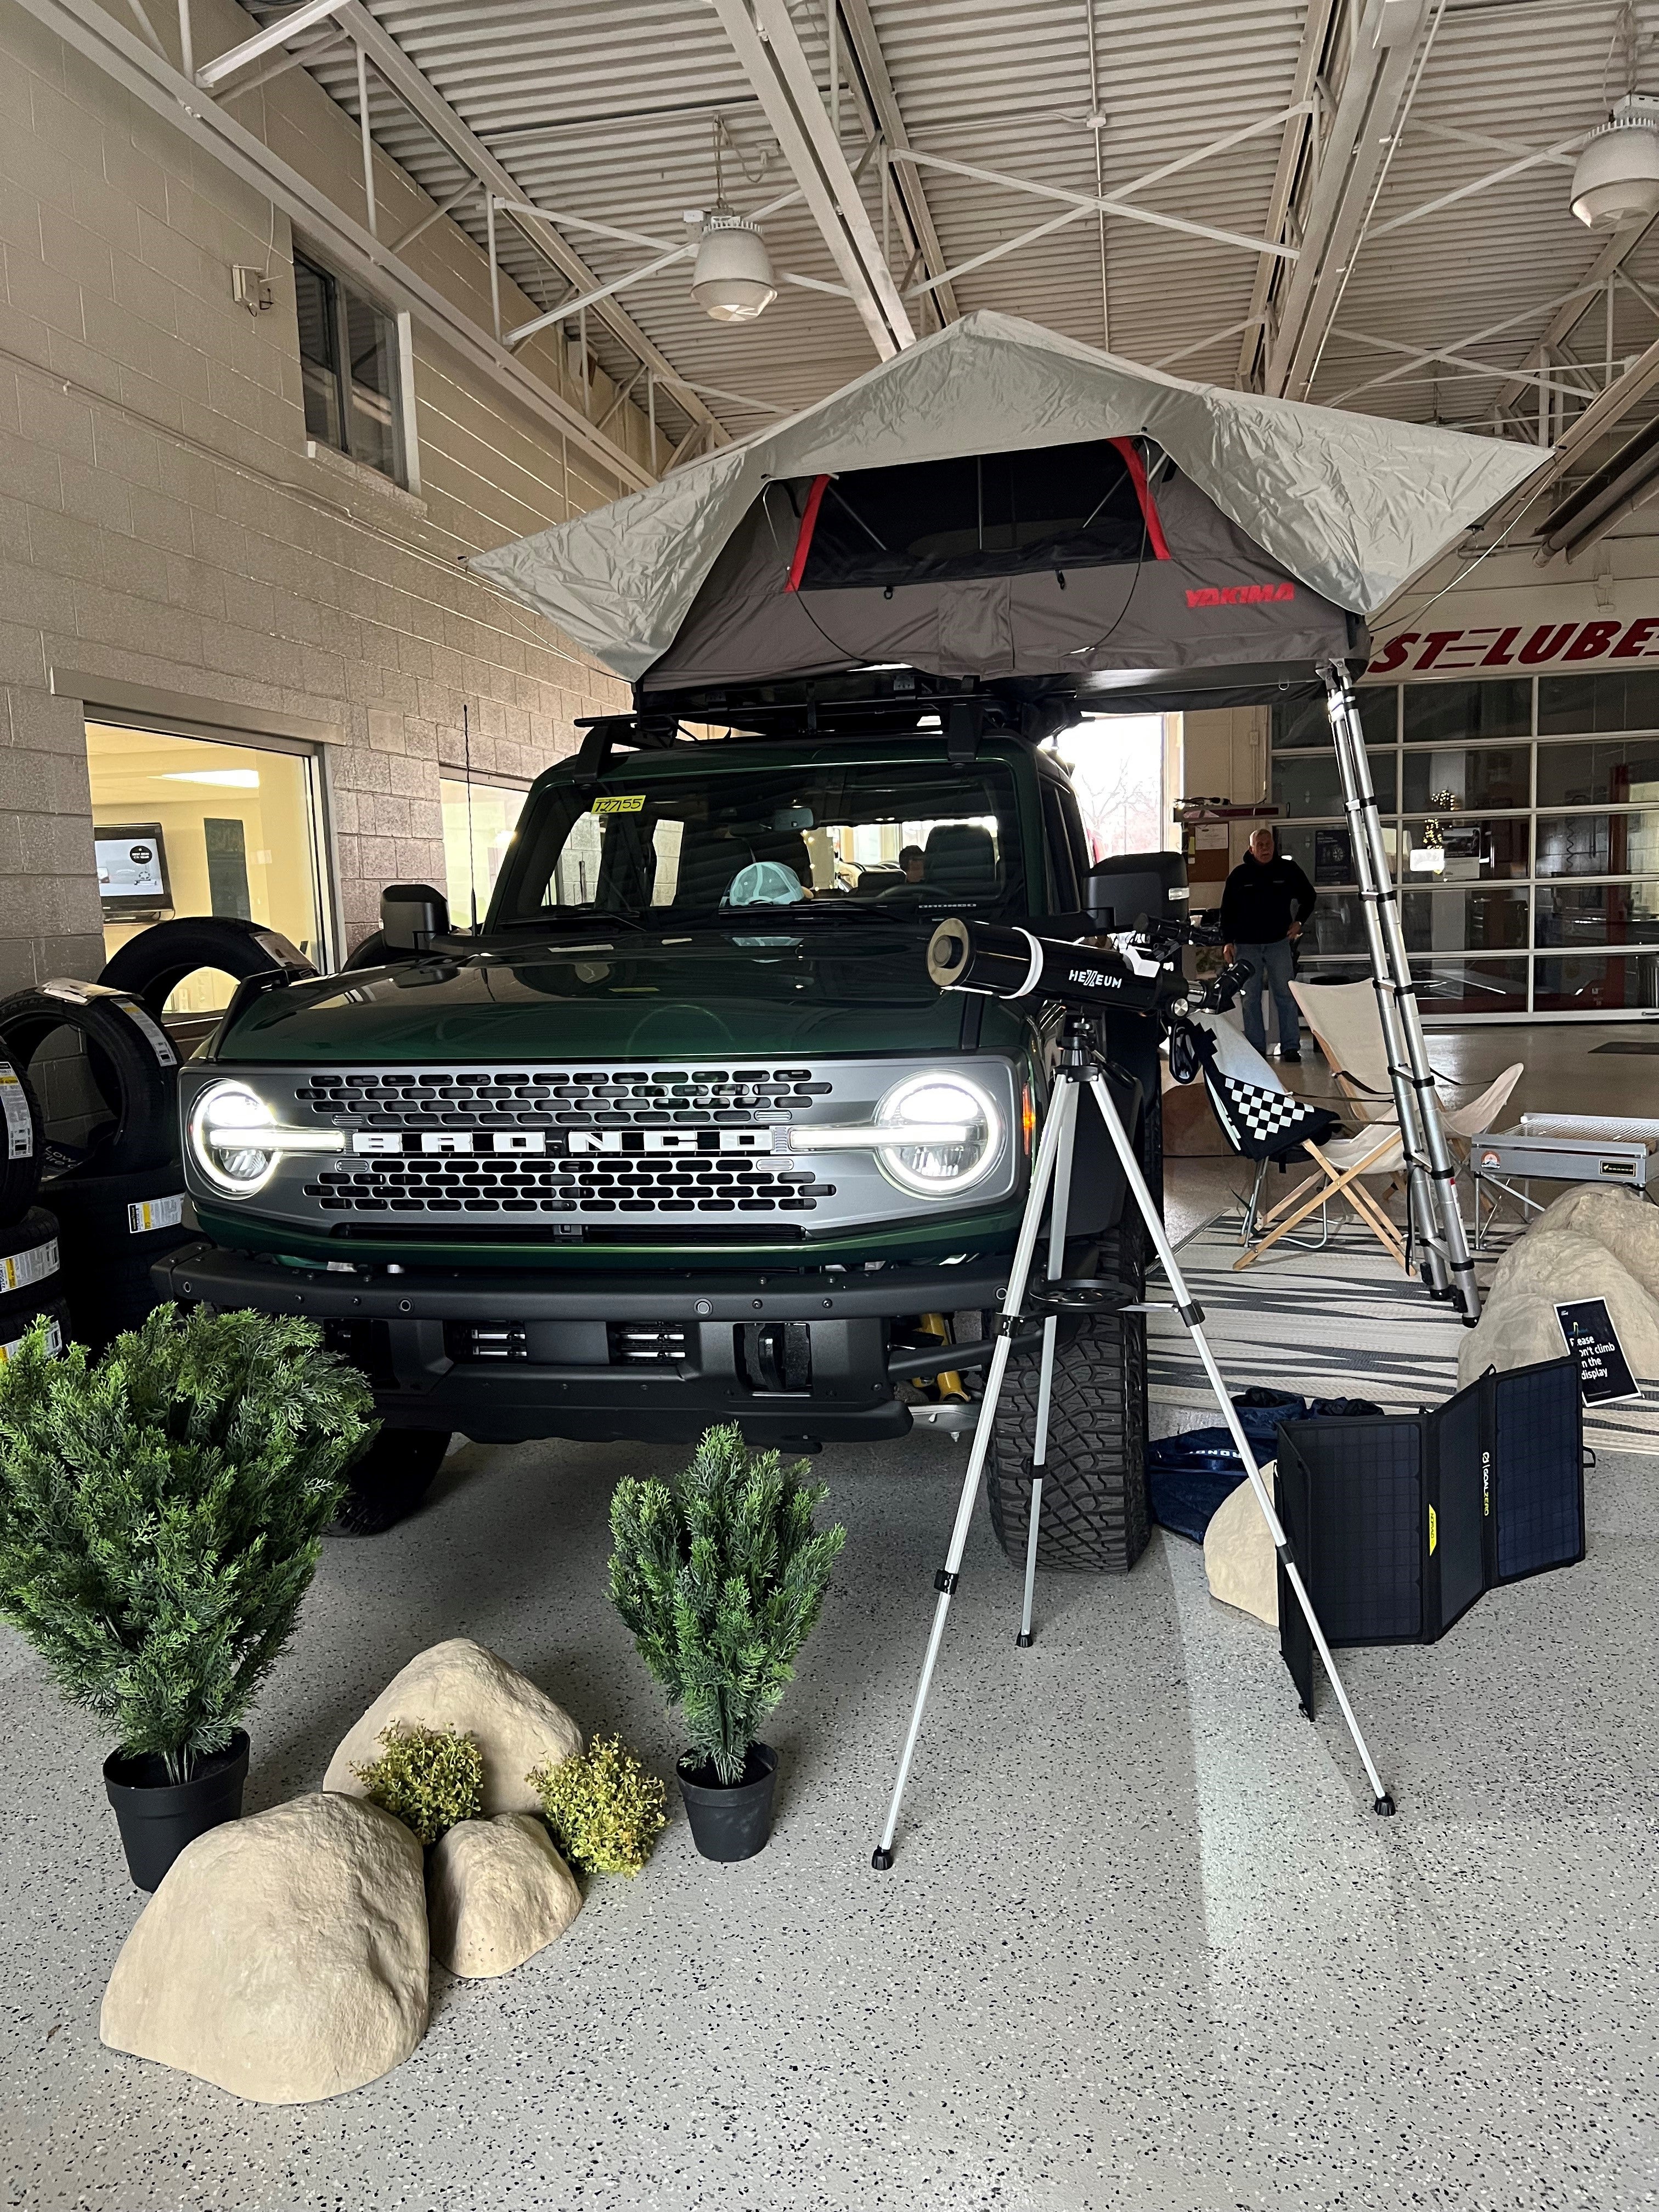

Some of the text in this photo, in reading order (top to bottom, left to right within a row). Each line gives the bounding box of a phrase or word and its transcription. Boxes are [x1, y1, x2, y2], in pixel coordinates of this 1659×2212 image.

[1185, 582, 1295, 608] YAKIMA
[352, 1129, 774, 1153] BRONCO
[1569, 1336, 1595, 1347] Pease
[1594, 1342, 1615, 1355] climb
[1588, 1357, 1602, 1367] the
[1581, 1368, 1608, 1380] display
